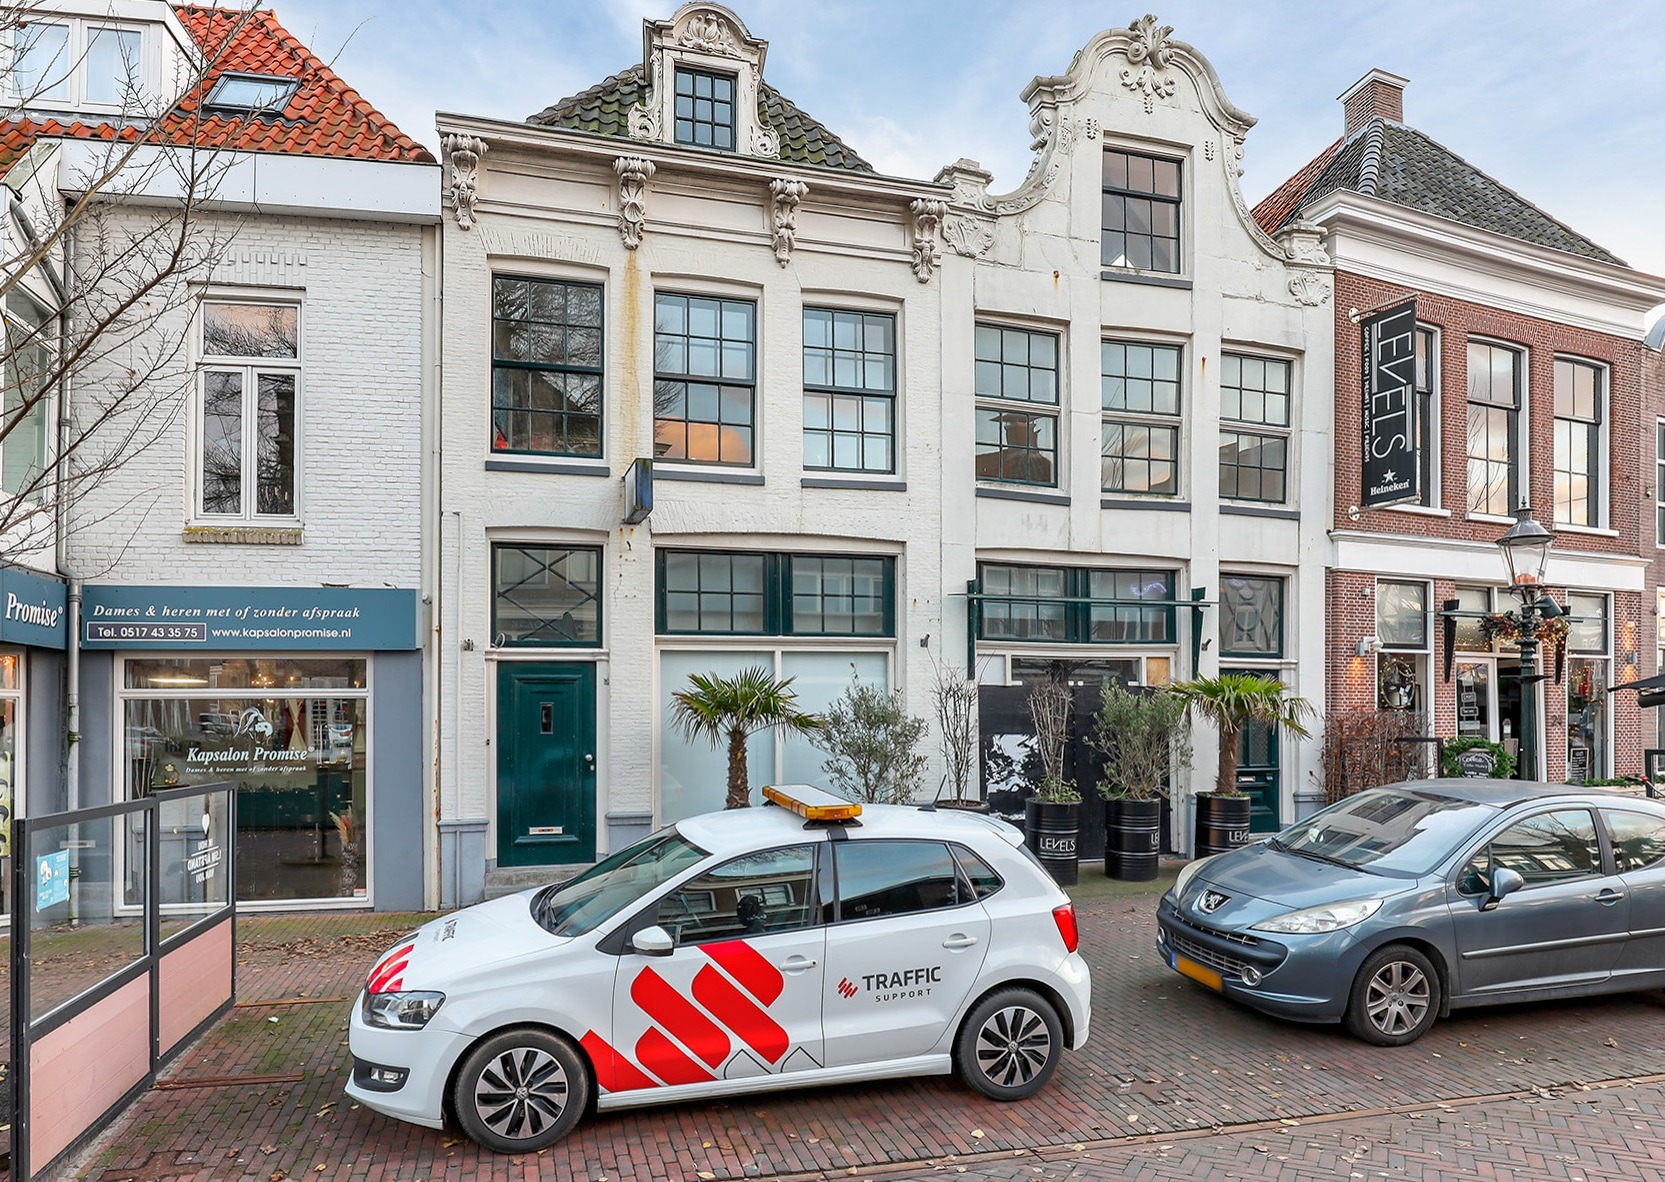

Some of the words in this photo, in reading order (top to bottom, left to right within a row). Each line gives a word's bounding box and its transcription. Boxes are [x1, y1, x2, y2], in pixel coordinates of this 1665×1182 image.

[1372, 310, 1414, 459] LEVELS
[1370, 480, 1410, 496] Heineken
[93, 605, 140, 617] Dames
[145, 605, 156, 617] &
[162, 605, 201, 617] heren
[206, 607, 230, 617] met
[235, 606, 251, 620] of
[253, 606, 299, 618] zonder
[302, 606, 360, 620] afspraak
[98, 627, 117, 637] Tel.
[120, 627, 147, 637] 0517
[151, 627, 165, 637] 43
[167, 628, 181, 638] 35
[184, 628, 198, 638] 75
[211, 627, 352, 639] www.kapsalonpromise.nl
[187, 747, 250, 766] Kapsalon
[1040, 837, 1076, 852] LEVELS
[862, 966, 941, 991] TRAFFIC
[875, 988, 932, 1002] SUPPORT
